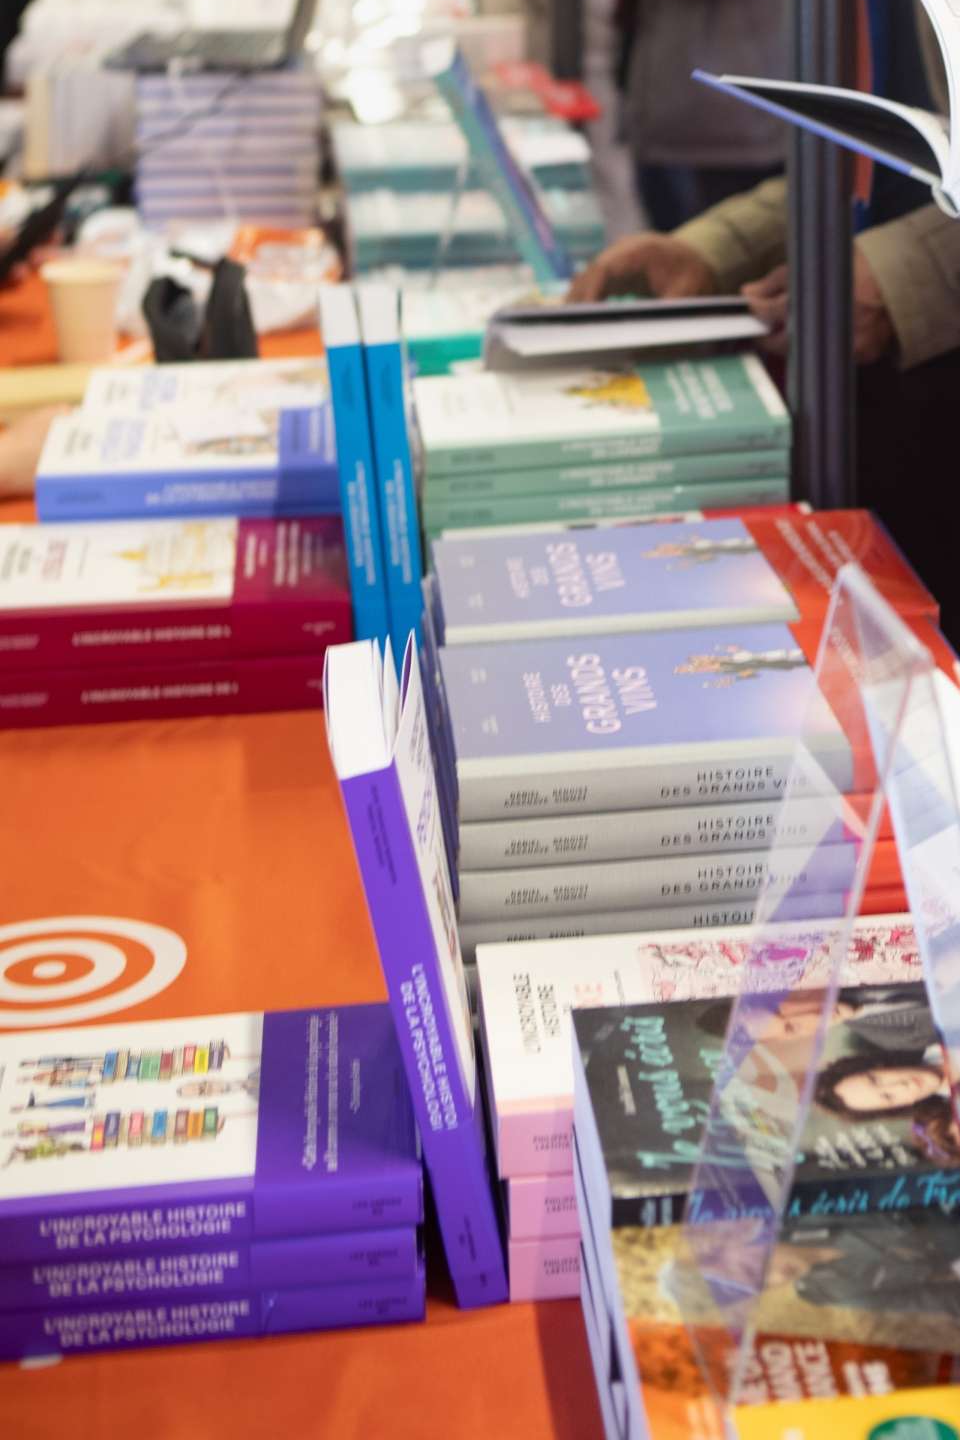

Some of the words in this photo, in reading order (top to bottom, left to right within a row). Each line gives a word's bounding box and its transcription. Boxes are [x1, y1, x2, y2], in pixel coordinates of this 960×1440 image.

[546, 542, 593, 608] GRANDS
[586, 551, 626, 592] VINS
[522, 671, 552, 723] HISTOIRE
[566, 652, 623, 734] GRANDS
[611, 665, 658, 716] VINS
[660, 785, 692, 799] DES
[698, 781, 766, 795] GRANDS
[697, 766, 774, 782] HISTOIRE
[661, 832, 692, 848] DES
[699, 828, 767, 844] GRANDS
[697, 814, 775, 832] HISTOIRE
[661, 881, 692, 897] DES
[400, 980, 416, 1006] DE
[406, 1006, 421, 1030] LA
[412, 962, 447, 1067] L'INCROYABLE
[436, 1074, 458, 1131] HISTOI
[411, 1028, 444, 1131] PSYCHOLOGI
[39, 1207, 163, 1238] L'INCROYABLE
[167, 1201, 246, 1222] HISTOIRE
[56, 1232, 80, 1250] DE
[83, 1230, 107, 1247] LA
[109, 1219, 232, 1245] PSYCHOLOGIE
[32, 1258, 157, 1285] L'INCROYABLE
[160, 1250, 239, 1271] HISTOIRE
[49, 1280, 72, 1298] DE
[76, 1278, 100, 1296] LA
[102, 1268, 225, 1293] PSYCHOLOGIE
[43, 1307, 168, 1336] L'INCROYABLE
[171, 1299, 250, 1320] HISTOIRE
[60, 1330, 84, 1347] DE
[87, 1327, 111, 1345] LA
[113, 1316, 235, 1343] PSYCHOLOGIE
